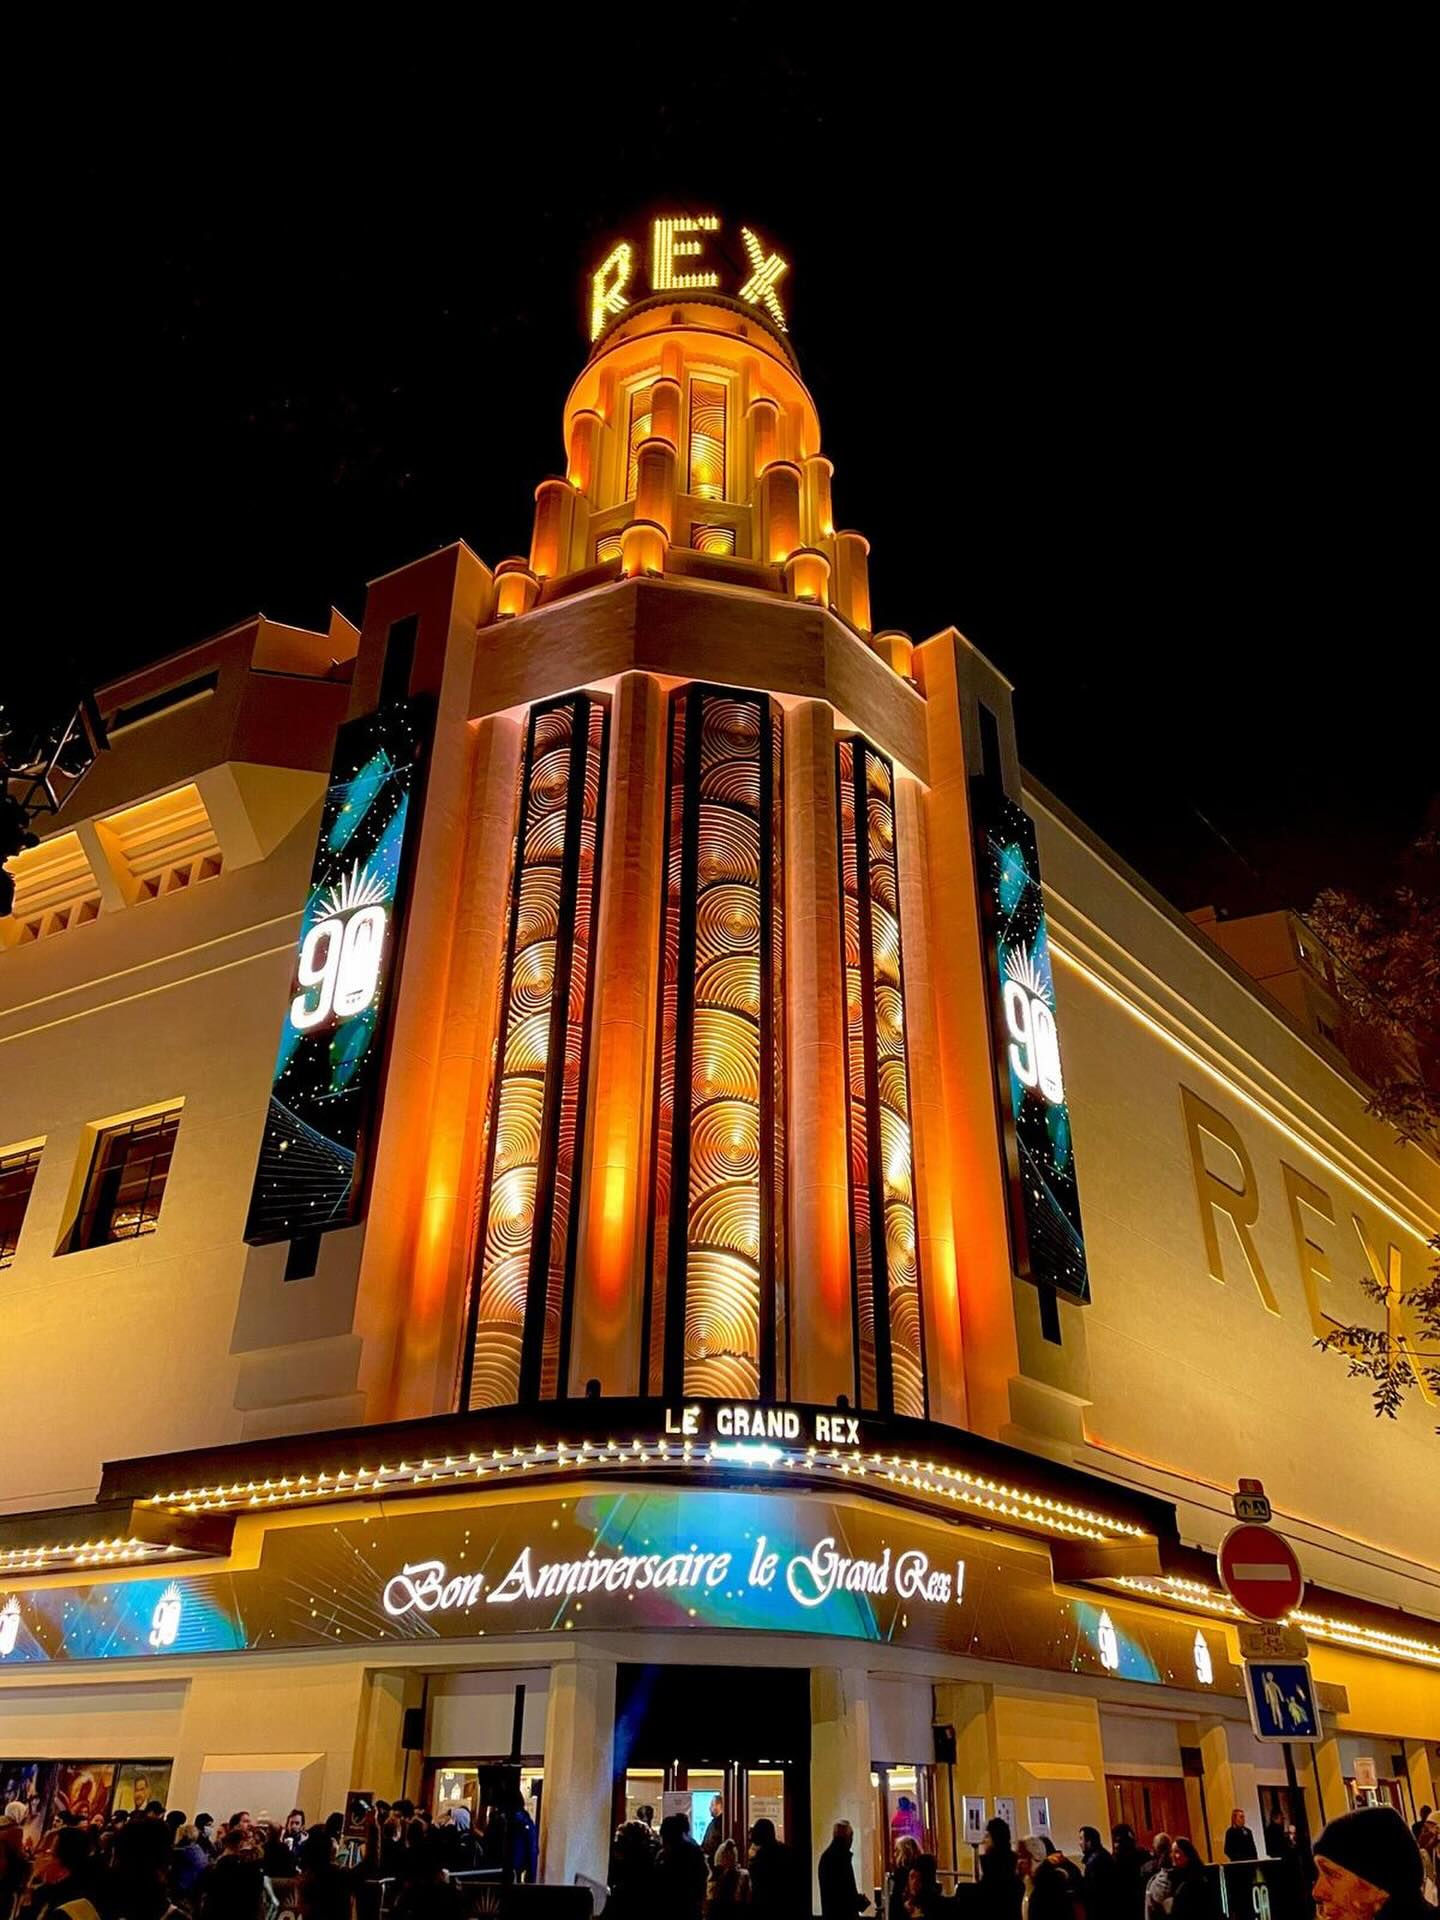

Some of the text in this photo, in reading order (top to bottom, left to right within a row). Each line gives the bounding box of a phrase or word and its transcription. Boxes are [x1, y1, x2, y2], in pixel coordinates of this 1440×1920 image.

[591, 215, 788, 342] REX
[290, 905, 386, 1029] 90
[1004, 979, 1064, 1105] 90
[665, 1407, 860, 1444] LE GRAND REX
[383, 1560, 485, 1615] Bon
[487, 1546, 732, 1602] Anniversaire
[748, 1536, 779, 1587] le
[787, 1537, 891, 1607] Grand
